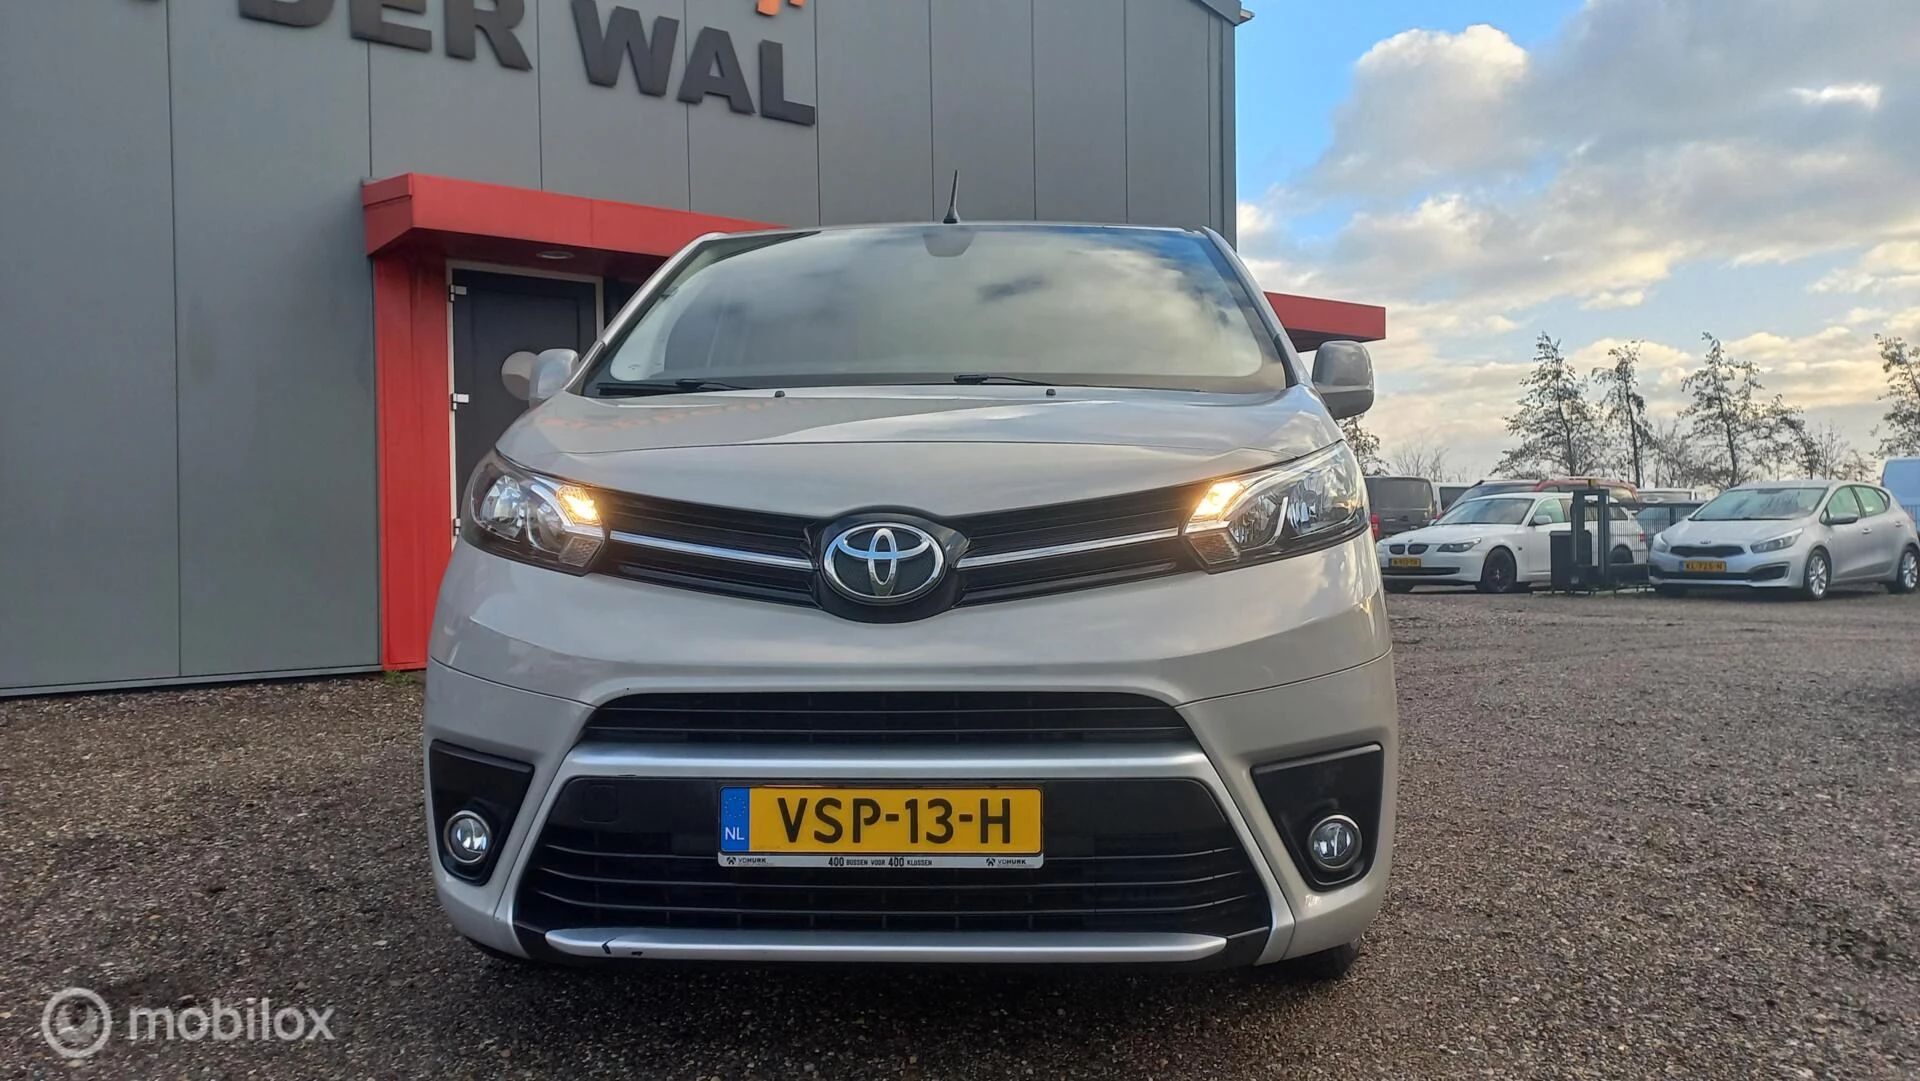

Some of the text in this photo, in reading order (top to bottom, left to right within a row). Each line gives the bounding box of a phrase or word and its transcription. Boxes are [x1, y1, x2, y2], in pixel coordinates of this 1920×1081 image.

[572, 0, 816, 126] WAL
[725, 827, 745, 841] NL
[777, 797, 1010, 844] VSP-13-H
[828, 857, 845, 867] 400
[888, 857, 905, 867] 400
